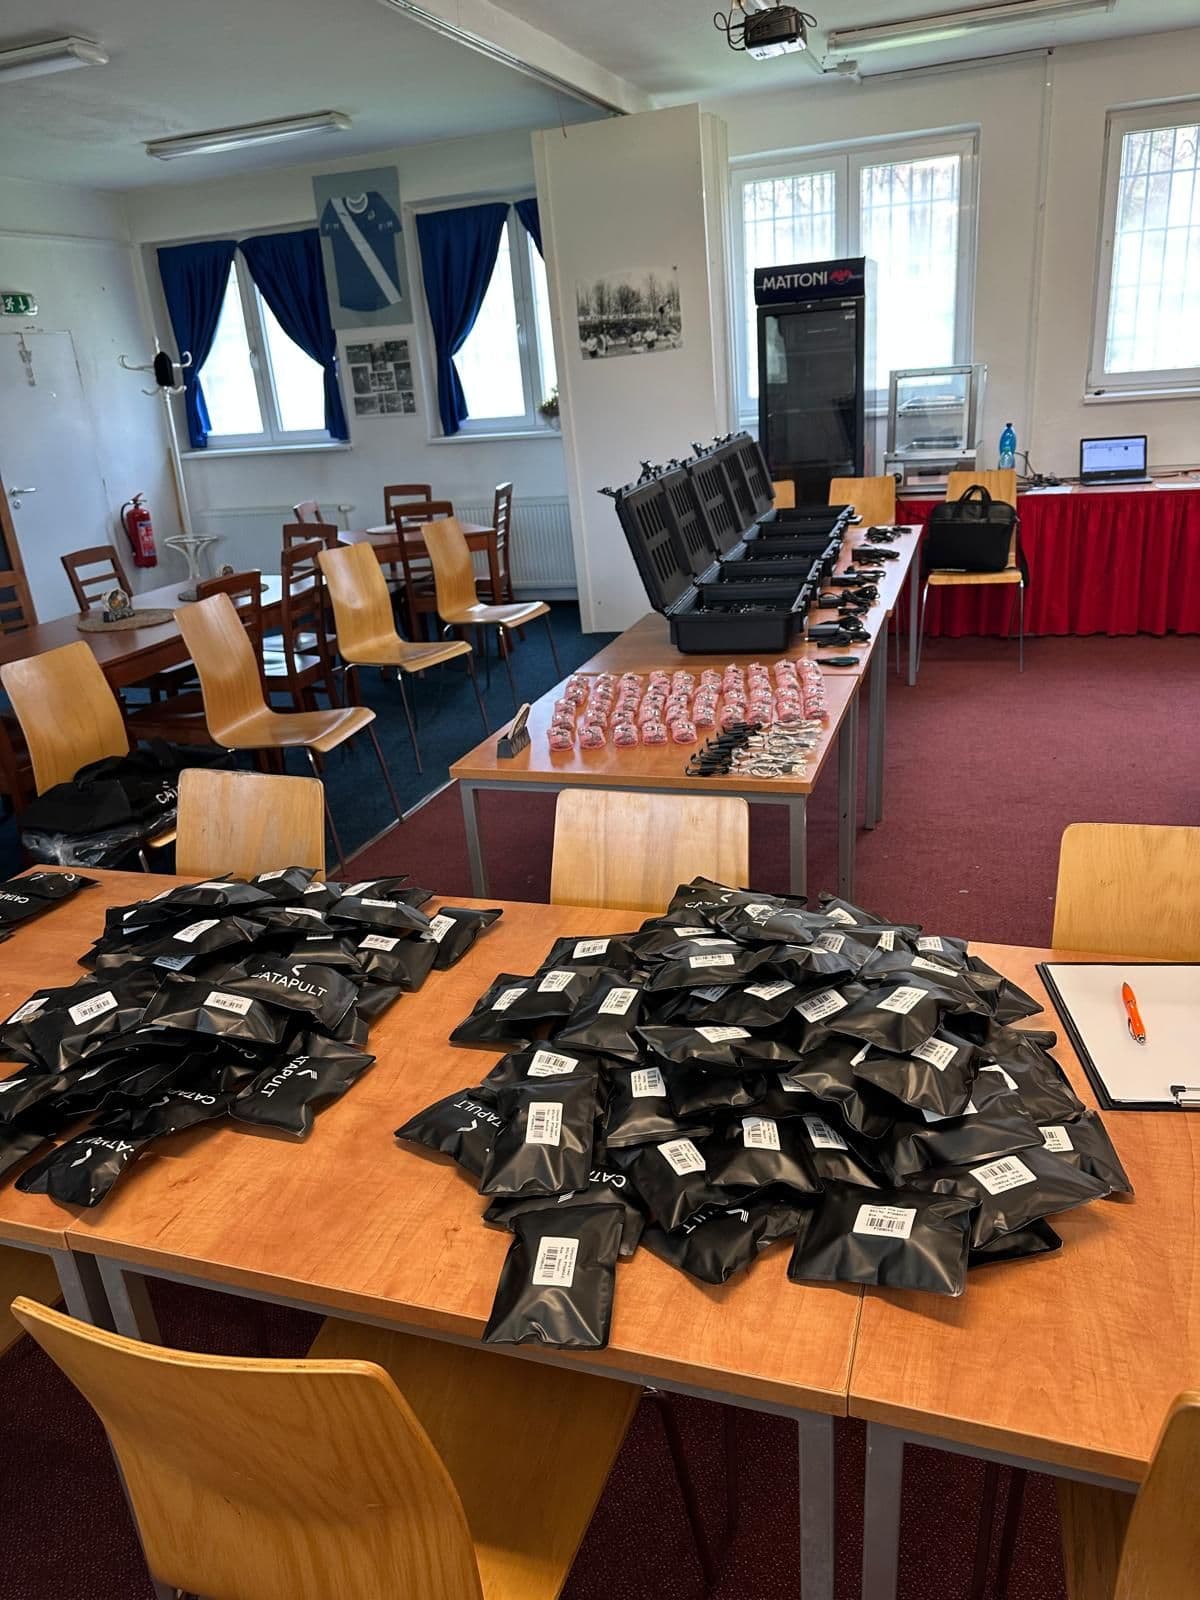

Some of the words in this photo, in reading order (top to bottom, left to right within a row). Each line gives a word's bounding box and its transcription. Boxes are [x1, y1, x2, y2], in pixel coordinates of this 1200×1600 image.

[763, 272, 828, 291] MATTONI
[453, 1099, 504, 1131] TAPULT
[76, 1138, 135, 1157] ATAPULT
